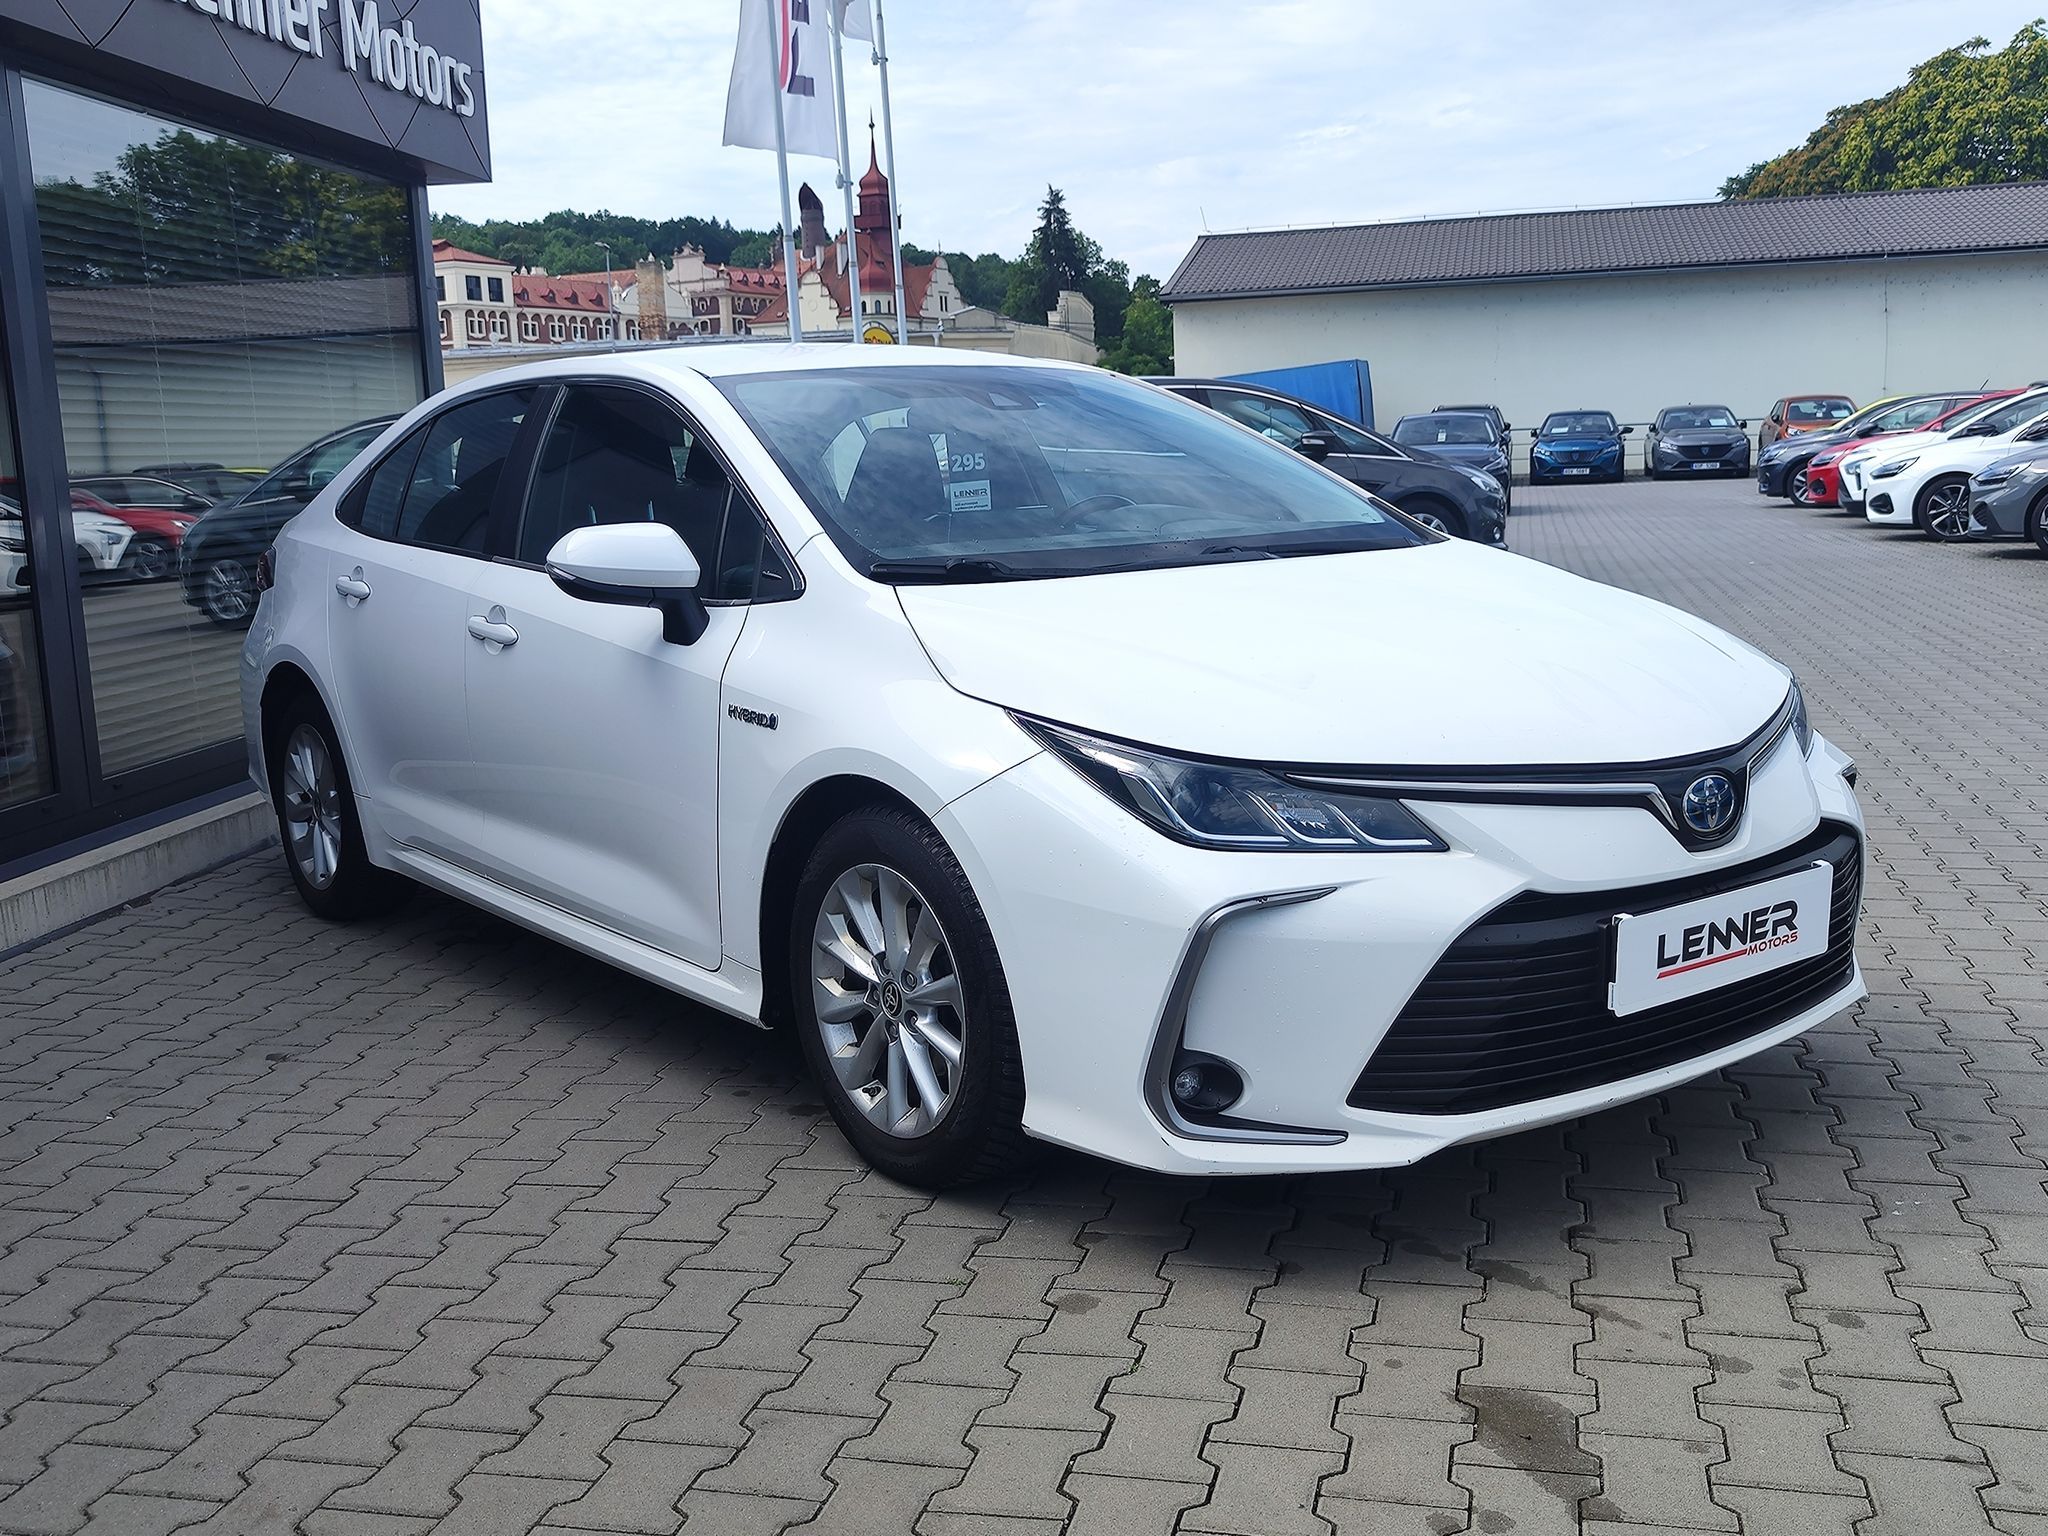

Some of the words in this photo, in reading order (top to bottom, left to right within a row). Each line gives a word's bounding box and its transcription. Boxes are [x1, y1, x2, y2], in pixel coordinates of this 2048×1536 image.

[339, 0, 476, 117] Motors
[951, 452, 986, 472] 295
[727, 703, 769, 728] HYBRID
[1656, 900, 1798, 969] LENNER
[1747, 931, 1798, 956] MOTORS
